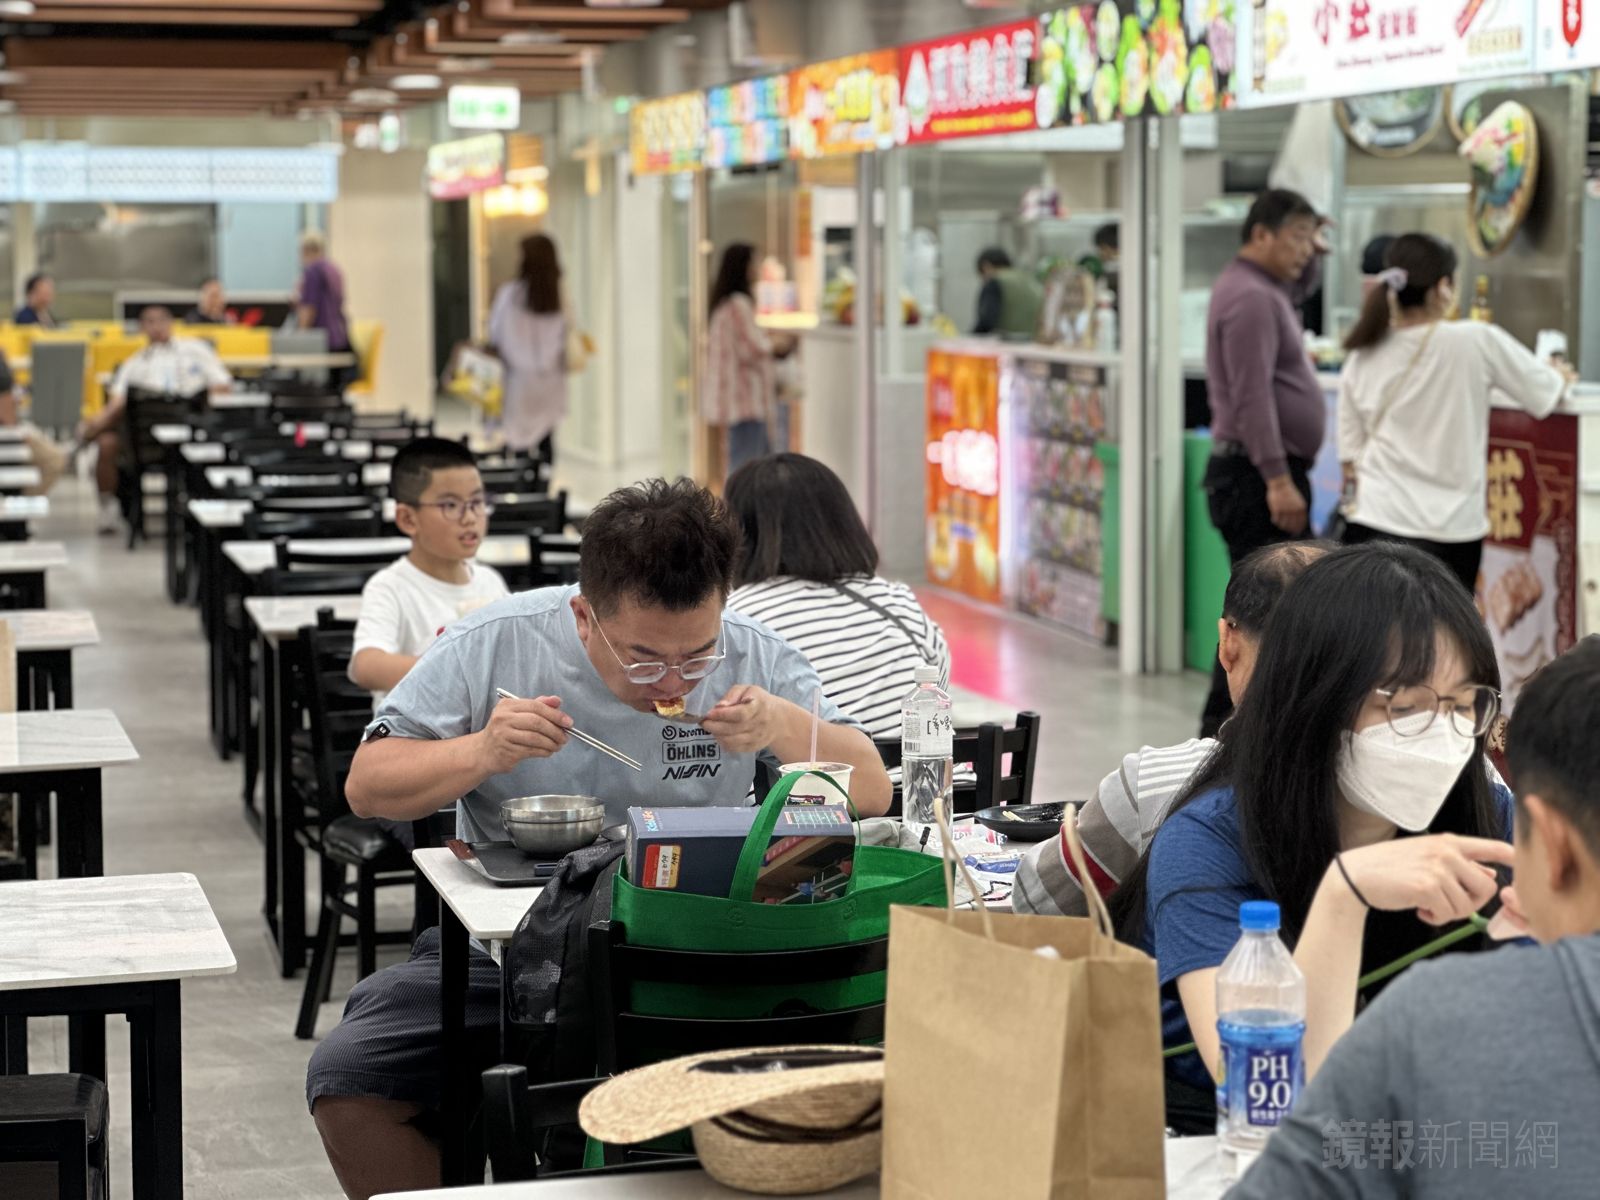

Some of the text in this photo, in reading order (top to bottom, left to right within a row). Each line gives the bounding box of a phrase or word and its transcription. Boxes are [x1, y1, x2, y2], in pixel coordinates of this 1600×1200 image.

[667, 743, 716, 761] ÖHLINS
[662, 764, 721, 780] NISIN
[1252, 1055, 1289, 1080] PH
[1248, 1080, 1291, 1109] 9.0
